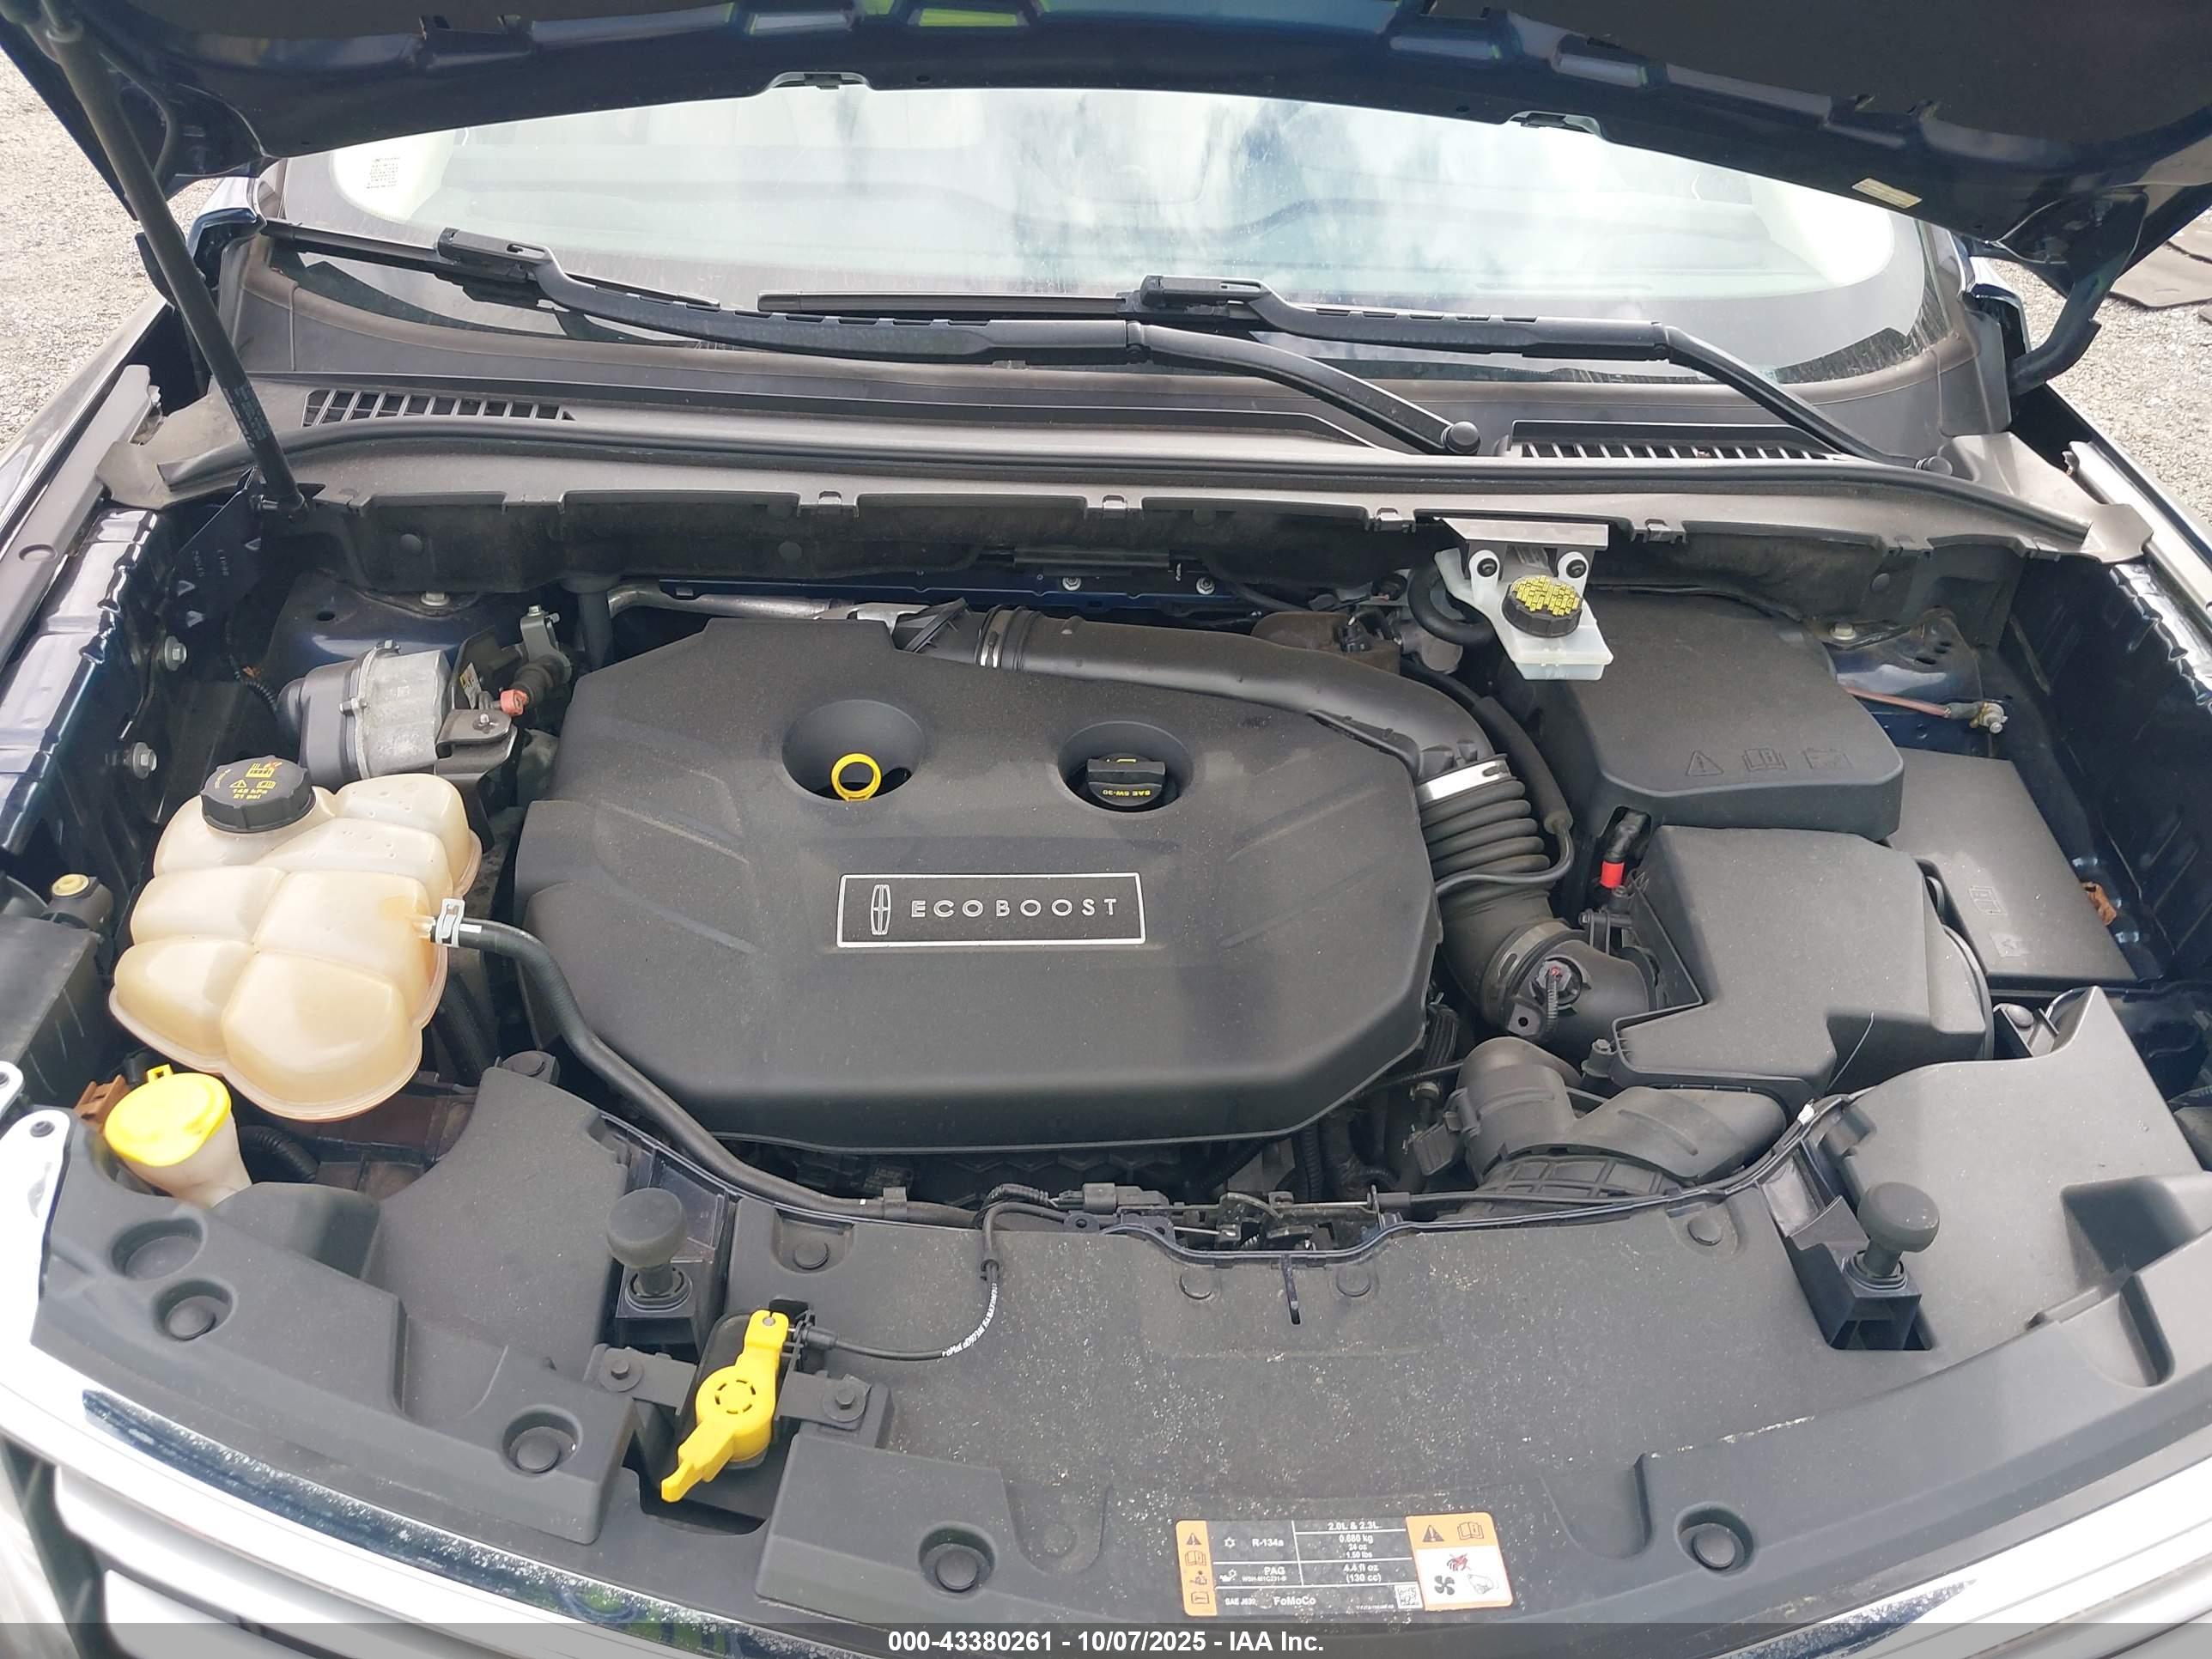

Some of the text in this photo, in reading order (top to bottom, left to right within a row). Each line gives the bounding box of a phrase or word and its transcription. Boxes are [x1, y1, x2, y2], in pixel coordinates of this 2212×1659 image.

[910, 897, 1118, 918] ECOBOOST
[1328, 1521, 1380, 1531] 2.0L & 2.3L
[1252, 1538, 1285, 1547] R-134a
[1339, 1534, 1374, 1544] 0.680 kg
[1264, 1566, 1285, 1576] PAG
[1346, 1573, 1382, 1583] (130 cc)
[1224, 1597, 1239, 1606] SAE
[1273, 1595, 1317, 1606] FoMoCo
